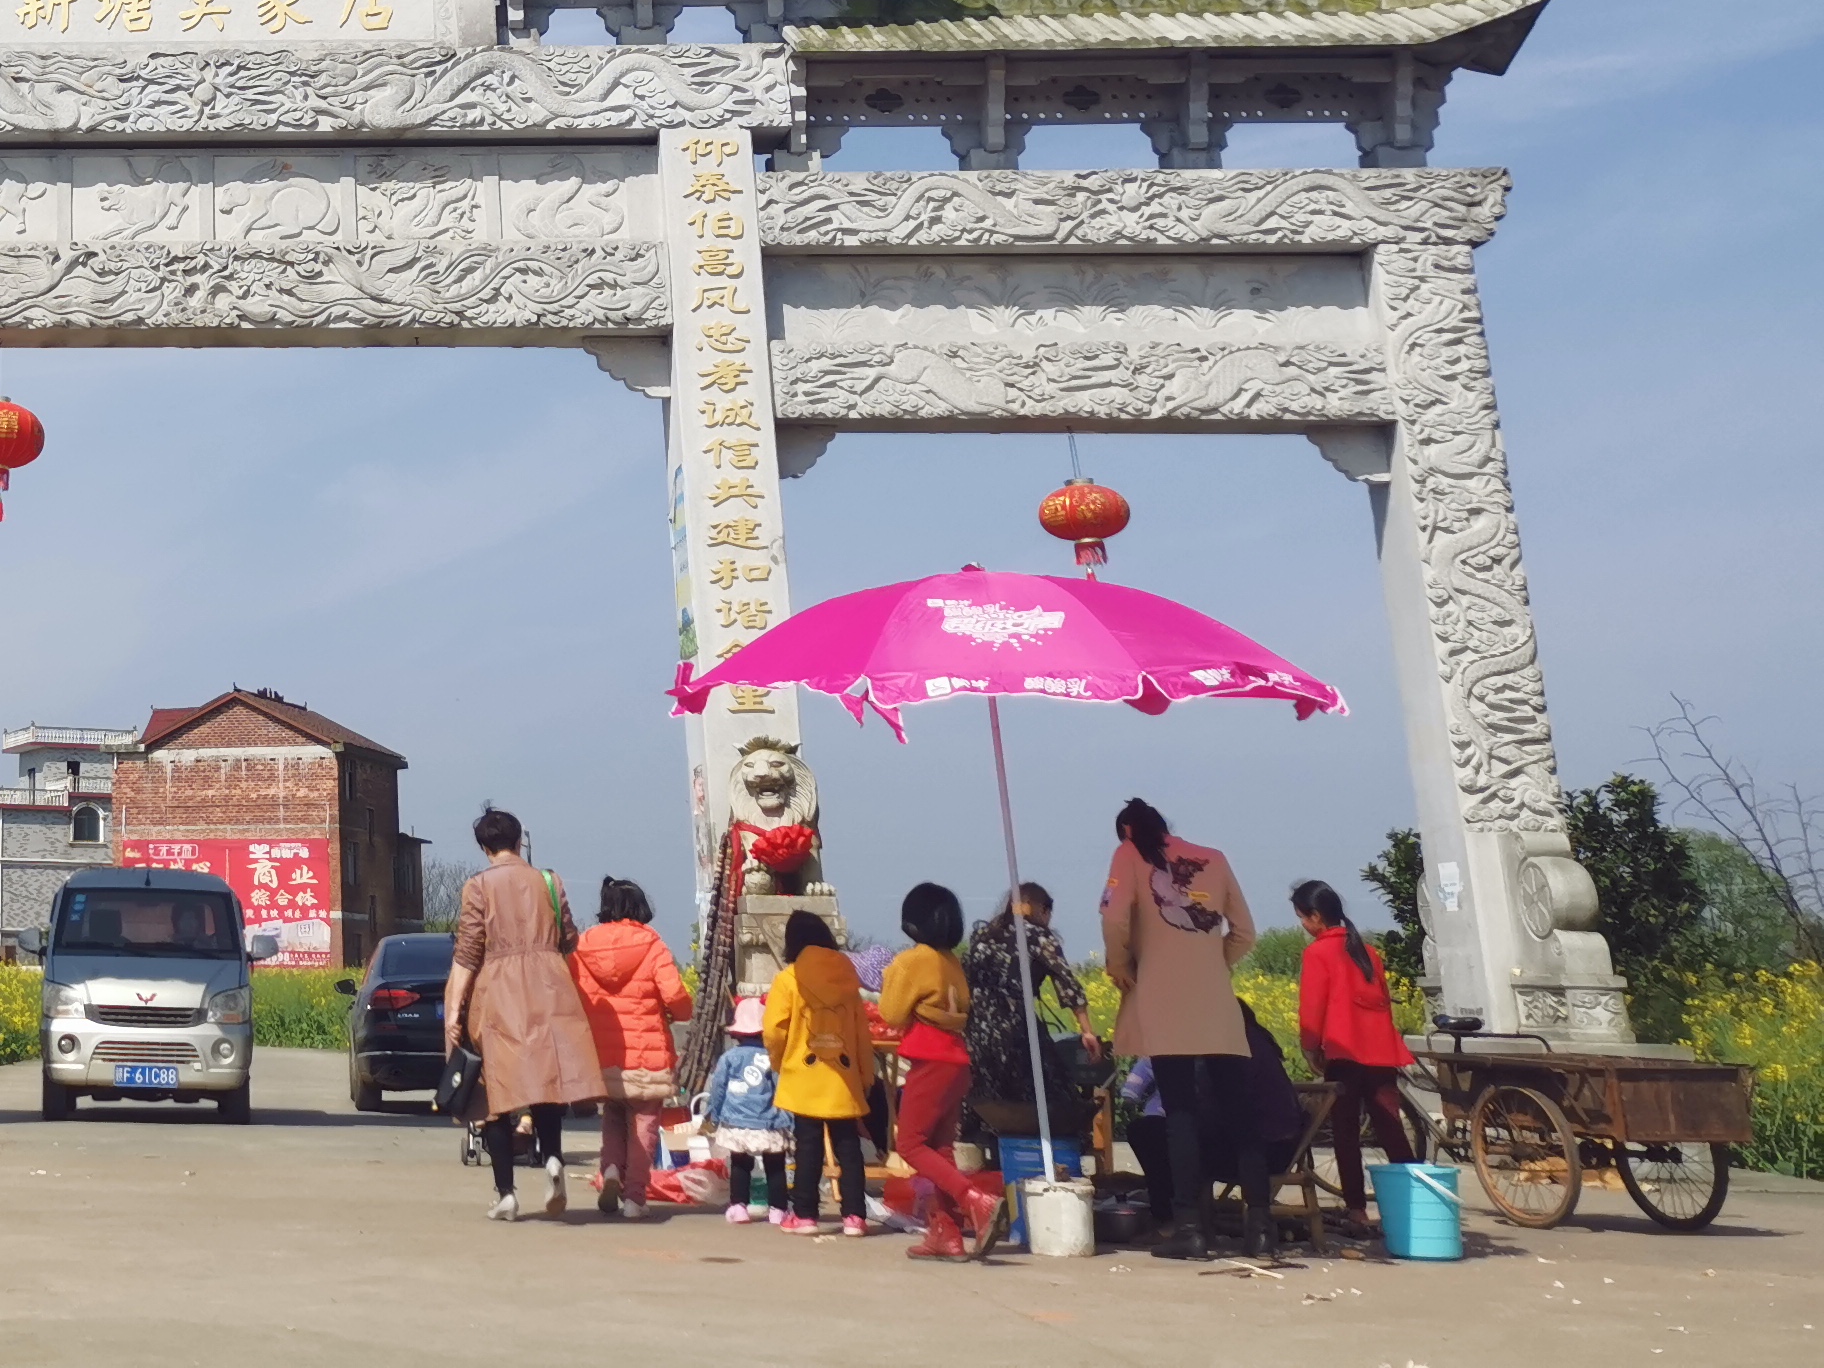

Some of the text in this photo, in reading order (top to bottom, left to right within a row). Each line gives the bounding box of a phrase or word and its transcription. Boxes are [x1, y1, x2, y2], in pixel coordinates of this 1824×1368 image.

[680, 136, 776, 714] 仰泰伯高风忠孝诚信共建和谐里
[1024, 675, 1093, 696] 酸酸乳
[246, 859, 319, 889] 商业
[250, 887, 319, 906] 综合体
